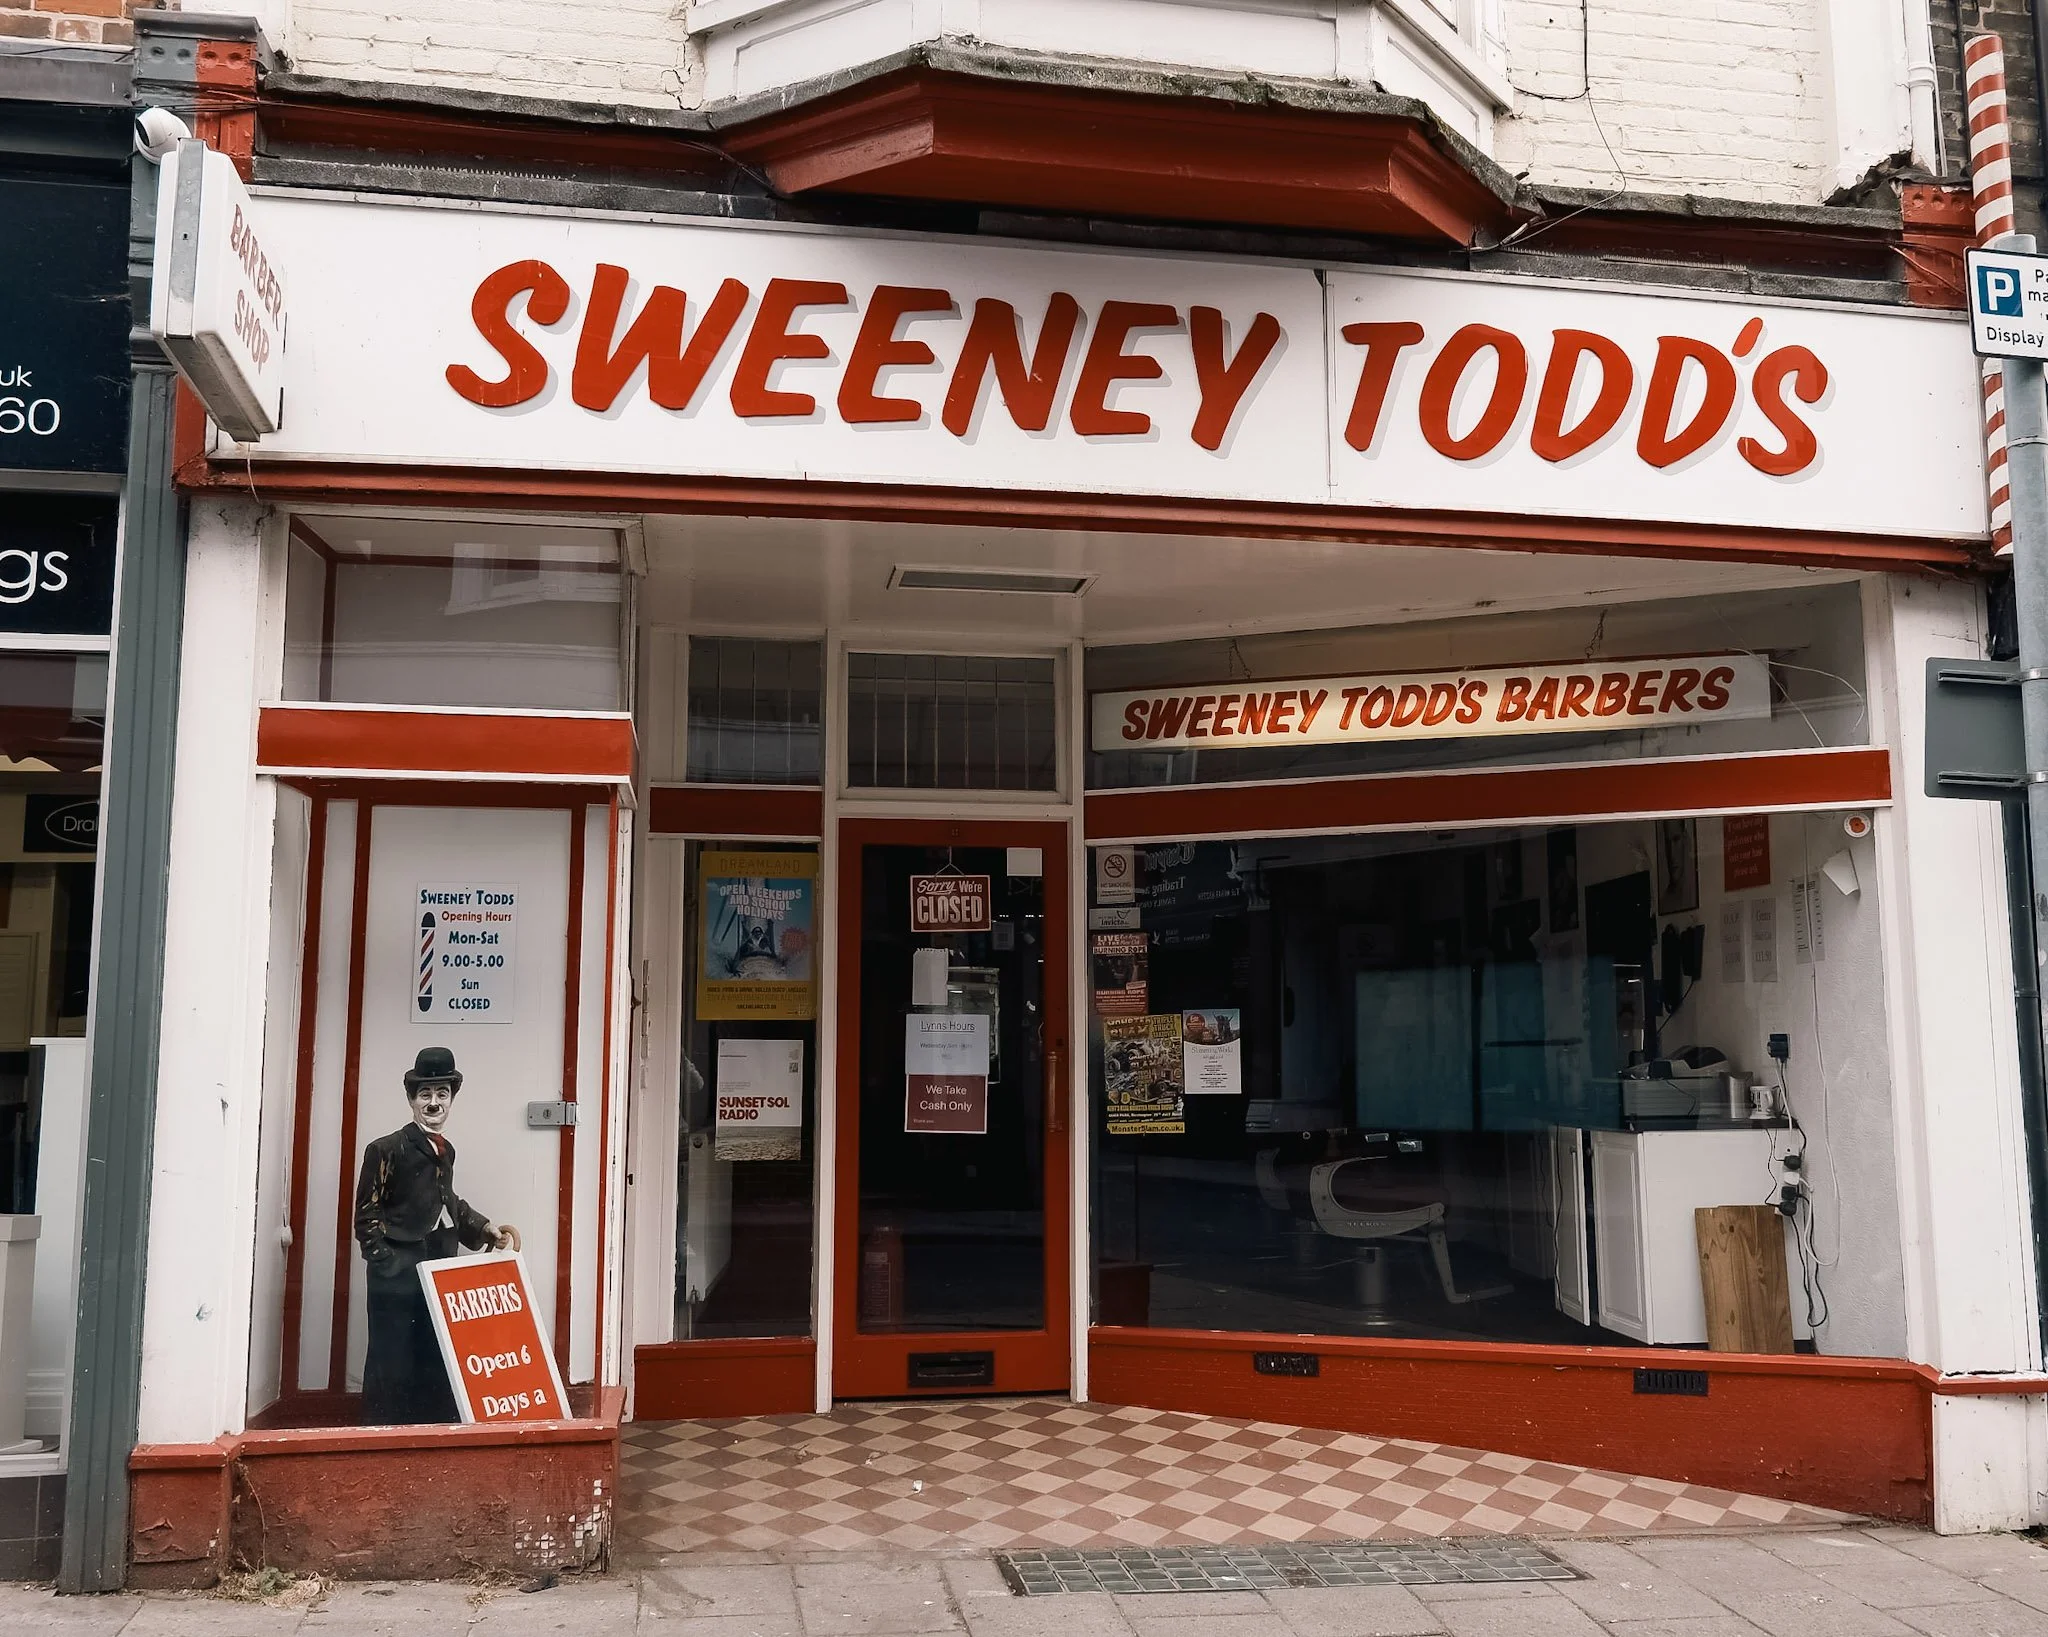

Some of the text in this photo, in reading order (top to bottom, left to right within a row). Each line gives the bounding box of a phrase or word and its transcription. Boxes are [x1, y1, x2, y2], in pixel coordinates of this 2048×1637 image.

[230, 203, 282, 331] BARBER
[1986, 271, 2015, 311] P
[234, 289, 270, 375] SHOP
[1986, 326, 2044, 348] Display
[445, 260, 1829, 477] SWEENEY TODD'S
[1121, 666, 1735, 742] SWEENEY TODD'S BARBERS
[720, 858, 802, 874] DREAMLAND
[719, 884, 802, 901] OPEN WEEKENDS
[916, 880, 983, 895] Sorry We're
[730, 894, 792, 911] AND SCHOOL
[916, 896, 983, 924] CLOSED
[441, 911, 512, 923] Opening Hours
[736, 906, 785, 921] HOLIDAYS
[448, 931, 499, 945] Mon-Sat
[442, 954, 505, 968] 9.00-5.00
[461, 978, 480, 990] Sun
[448, 998, 491, 1010] CLOSED
[921, 1021, 975, 1031] Lynns Hours
[926, 1085, 967, 1095] We Take
[920, 1100, 973, 1112] Cash Only
[720, 1109, 758, 1120] RADIO
[444, 1282, 522, 1323] BARBERS
[466, 1344, 532, 1378] Open 6
[482, 1388, 547, 1417] Days a
